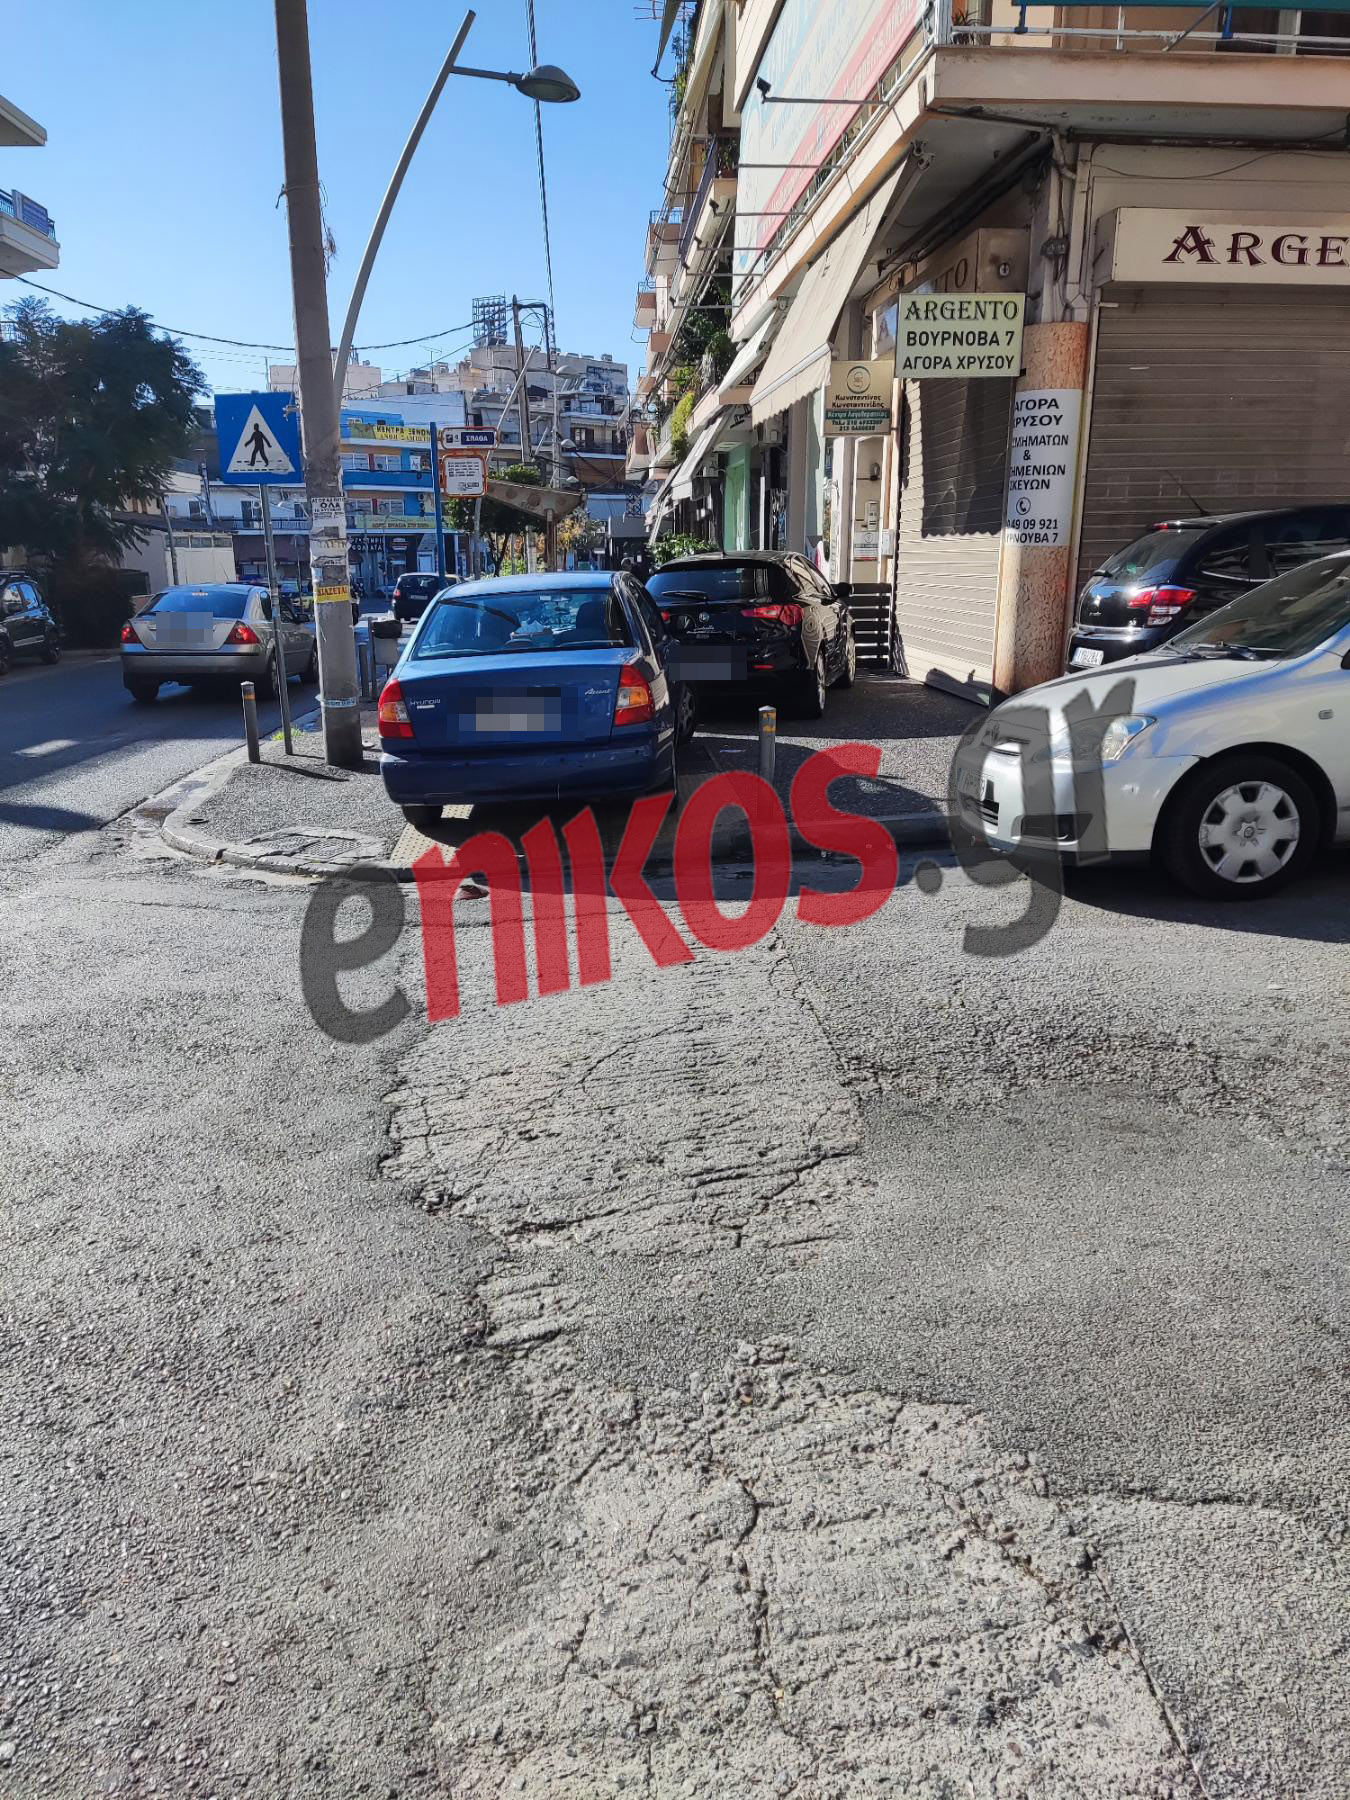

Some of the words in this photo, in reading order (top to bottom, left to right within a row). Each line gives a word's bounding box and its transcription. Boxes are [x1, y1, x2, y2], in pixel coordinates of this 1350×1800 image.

[904, 300, 1019, 321] ARGENTO
[906, 330, 1000, 346] ΒΟΥΡΝΟΒΑ
[1005, 330, 1015, 346] 7
[902, 356, 953, 370] ΑΓΟΡΑ
[956, 355, 1015, 370] ΧΡΥΣΟΥ
[1013, 414, 1064, 428] ΡΥΣΟΥ
[1023, 449, 1031, 460] &
[1010, 464, 1066, 477] ΗΜΕΝΙΩΝ
[1023, 519, 1036, 529] 09
[1039, 519, 1058, 529] 921
[1052, 532, 1059, 543] 7
[410, 698, 441, 706] HYUNDAI
